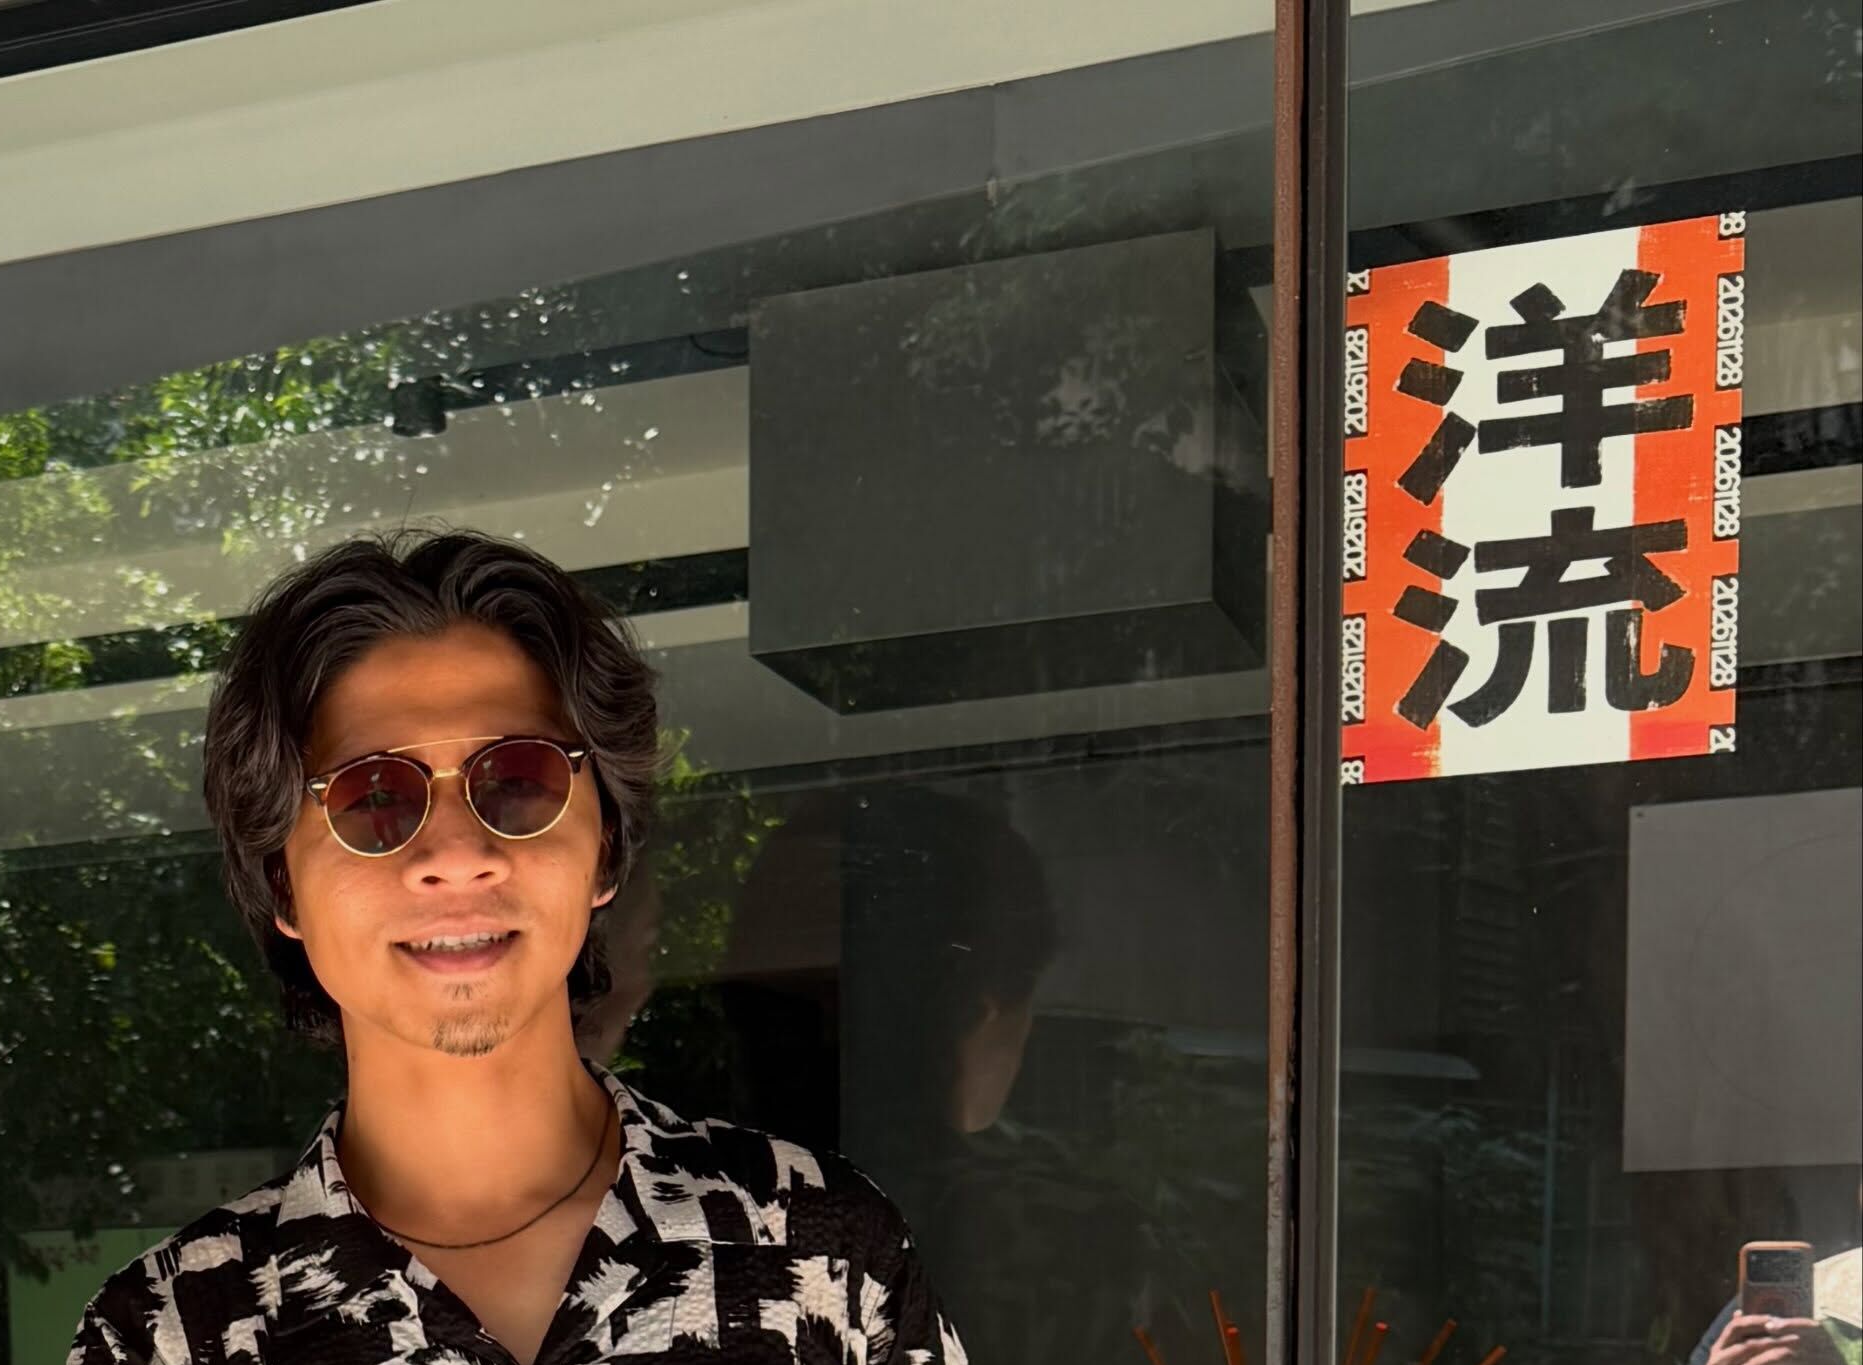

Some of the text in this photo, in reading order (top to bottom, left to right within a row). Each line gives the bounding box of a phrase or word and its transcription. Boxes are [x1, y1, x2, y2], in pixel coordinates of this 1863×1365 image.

[1344, 327, 1368, 436] 20261128
[1717, 276, 1744, 387] 20261128
[1343, 473, 1367, 580] 20261128
[1393, 268, 1696, 731] 洋流
[1713, 427, 1742, 538] 20261128
[1342, 617, 1366, 722] 20261128
[1710, 577, 1739, 688] 20261128
